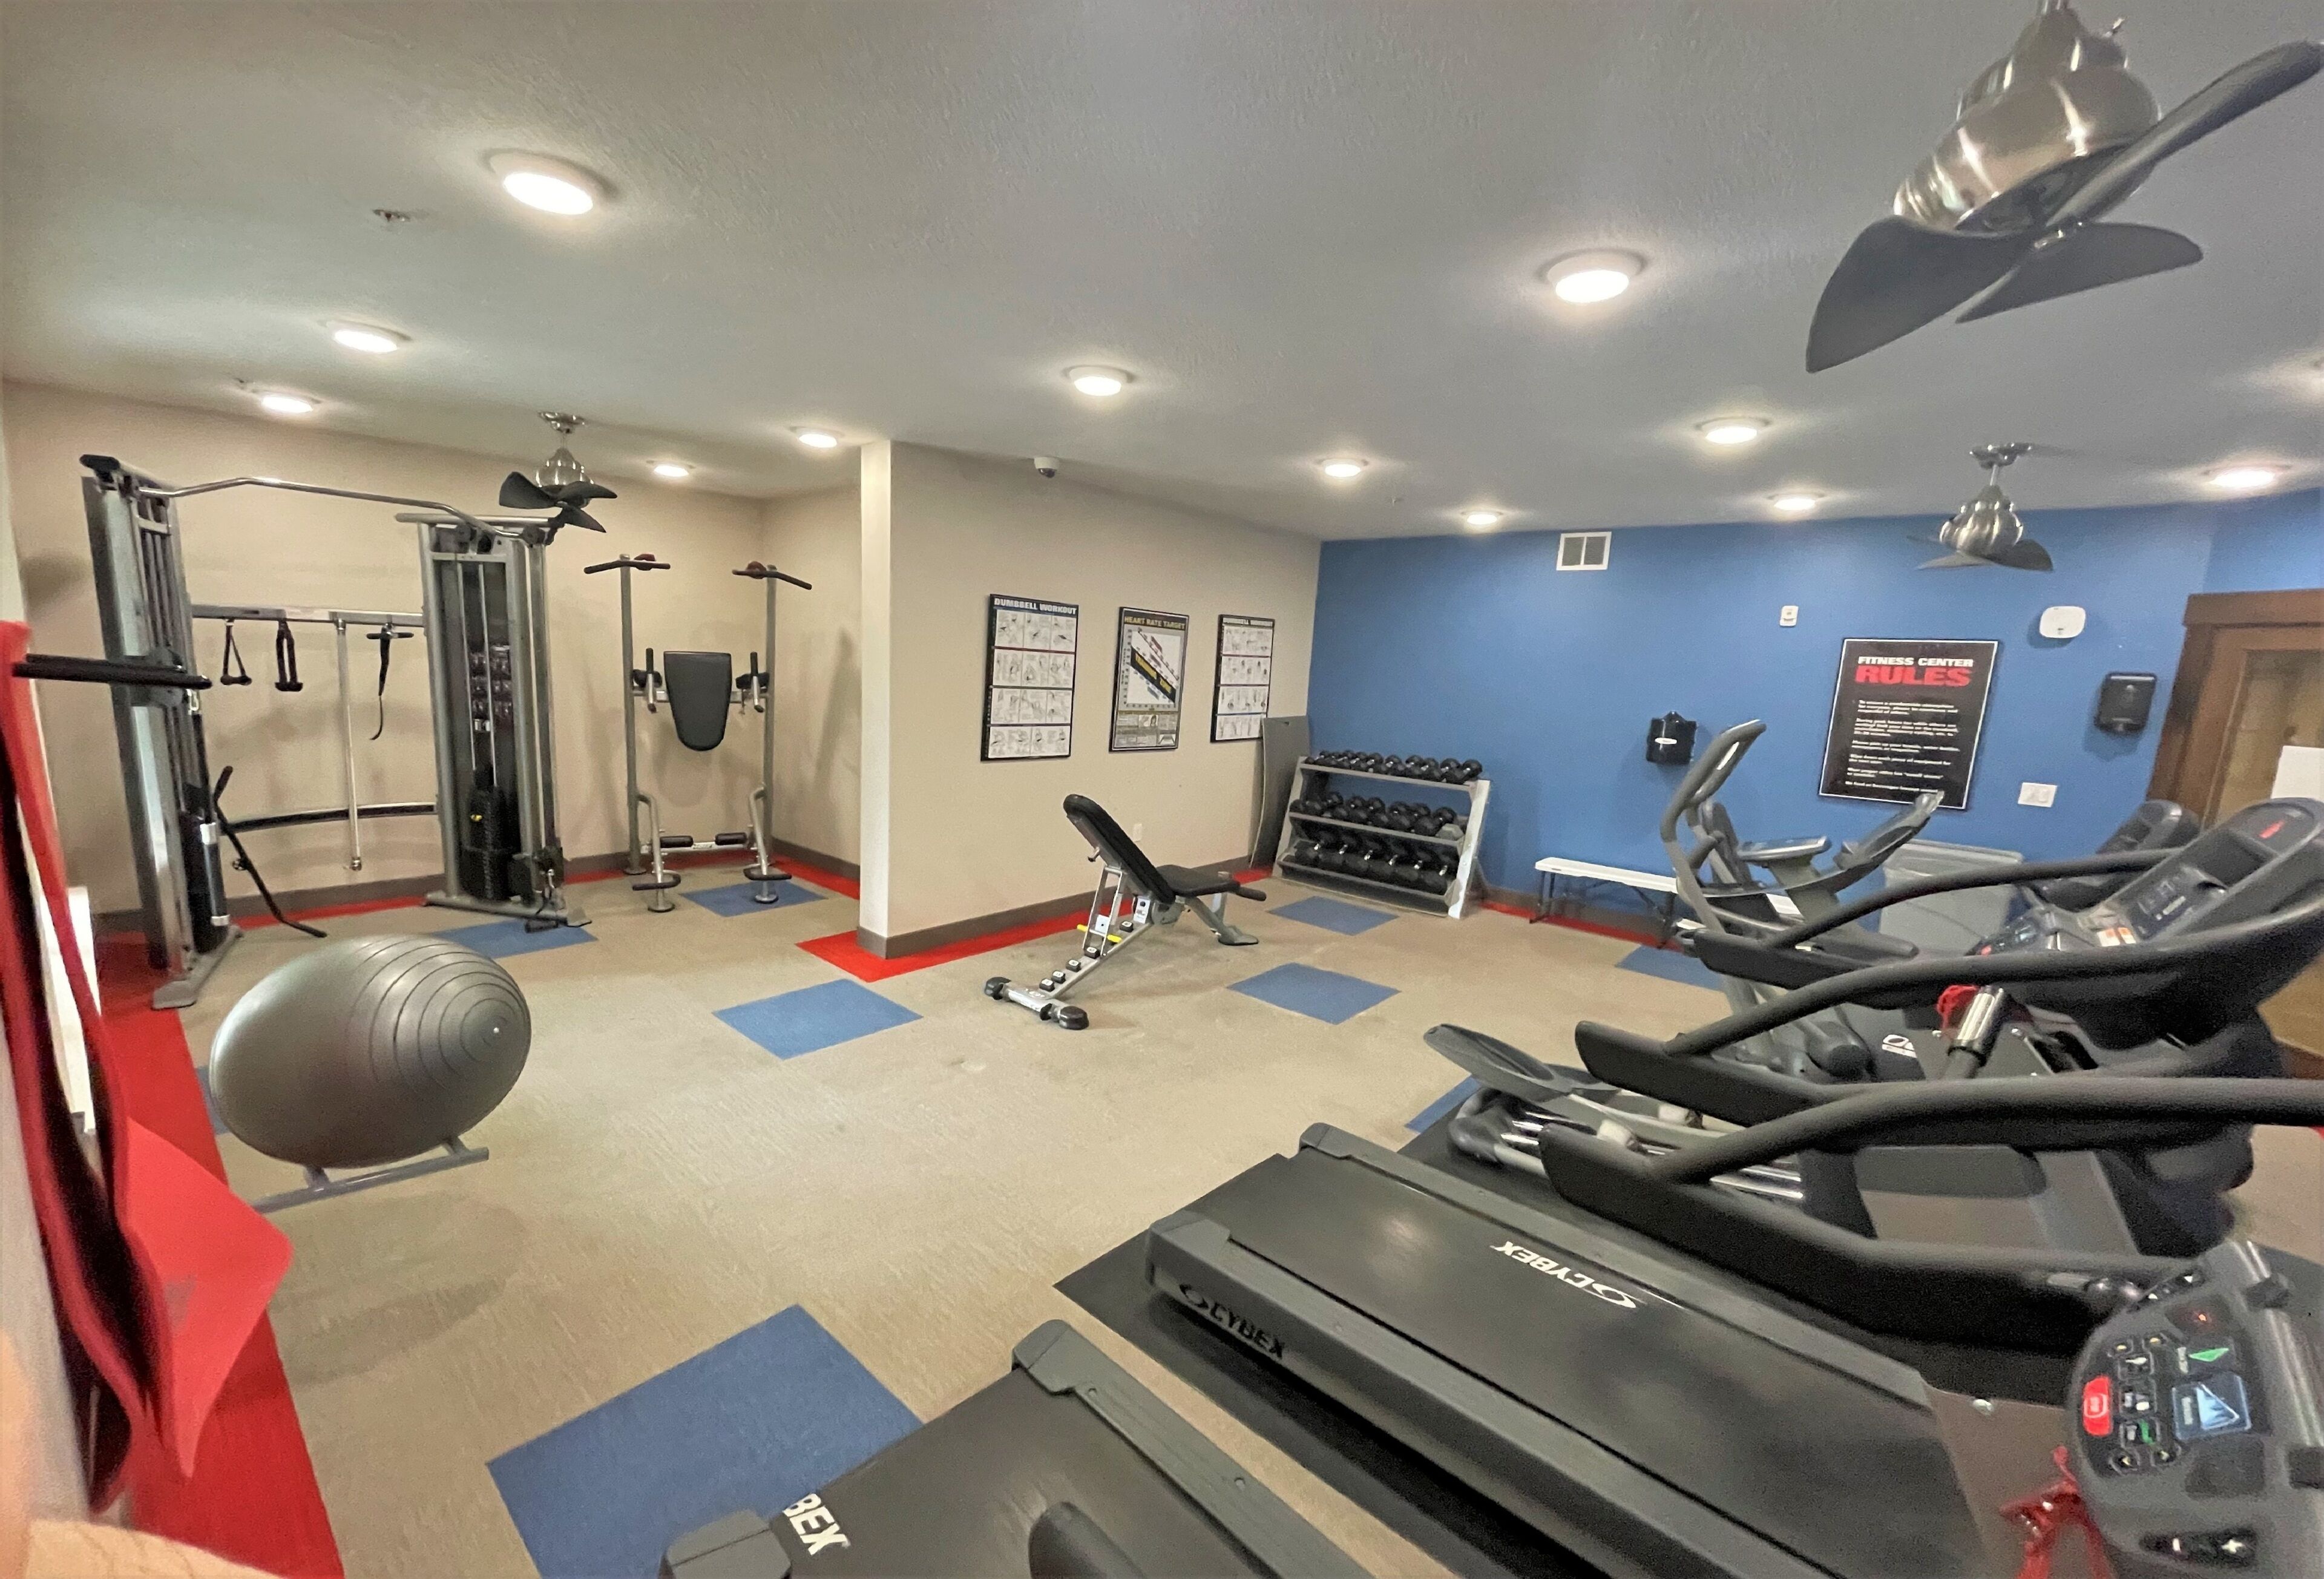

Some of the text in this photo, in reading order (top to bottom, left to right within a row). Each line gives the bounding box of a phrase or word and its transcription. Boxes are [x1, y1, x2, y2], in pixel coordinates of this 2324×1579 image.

[994, 597, 1077, 614] DUMBBELL WORKOUT
[1124, 616, 1146, 625] HEART
[1146, 618, 1163, 626] RATE
[1857, 656, 1974, 667] FITNESS CENTER
[1856, 666, 1972, 686] RULES
[1494, 1241, 1595, 1288] CYBEX
[1210, 1302, 1285, 1358] CYBEX
